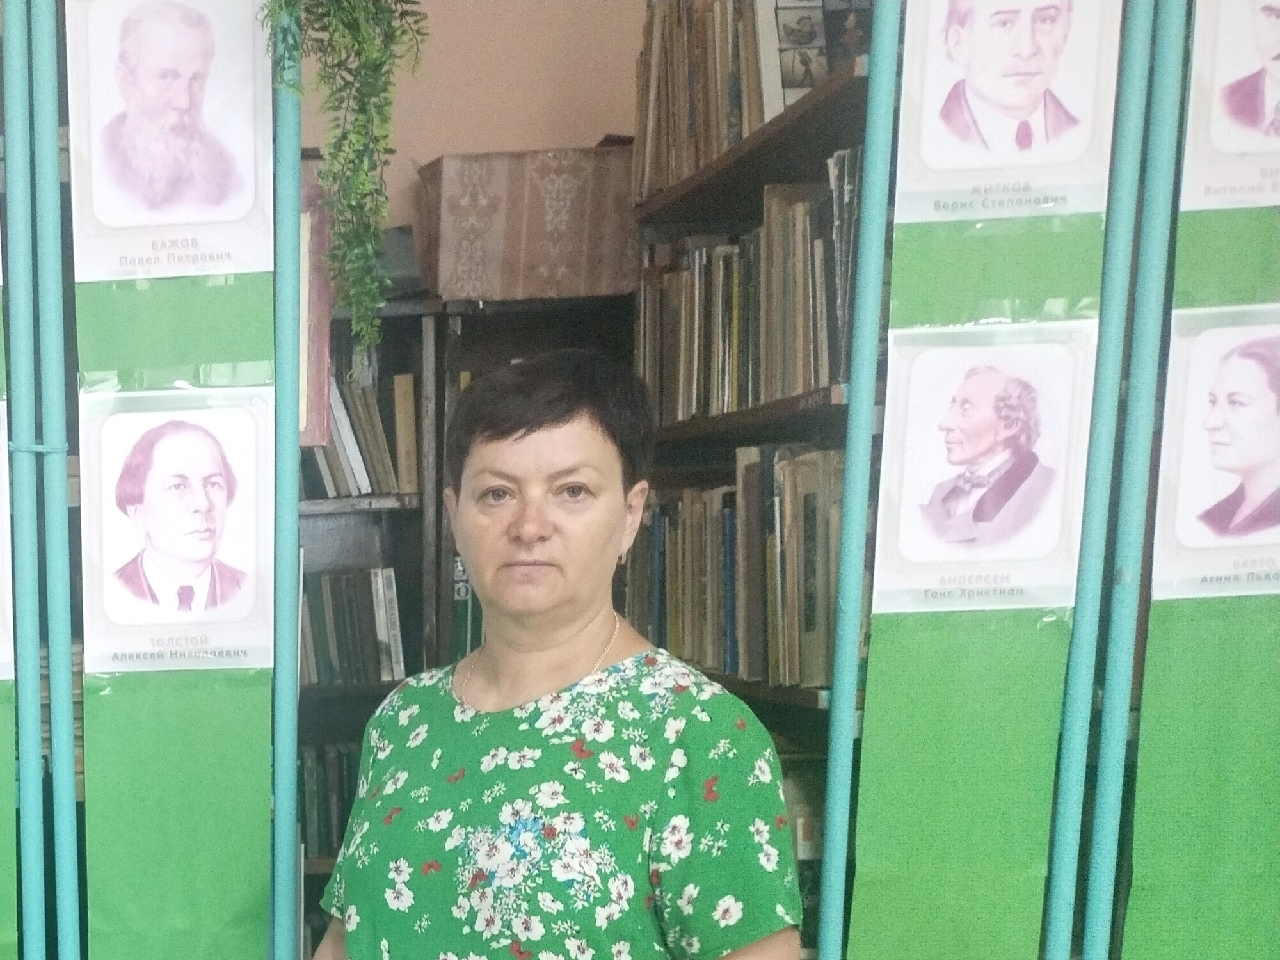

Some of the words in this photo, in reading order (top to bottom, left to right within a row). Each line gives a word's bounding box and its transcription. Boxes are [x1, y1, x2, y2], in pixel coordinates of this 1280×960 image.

[970, 180, 1032, 195] ЖИТКОВ
[933, 199, 975, 212] Борис
[981, 194, 1067, 209] Степанович
[152, 237, 199, 251] БАЖОВ
[119, 255, 160, 267] Павел
[167, 251, 231, 264] Петрович
[938, 573, 1010, 586] АНДЕРСЕН
[1200, 574, 1239, 584] Агния
[924, 588, 953, 600] Ганс
[958, 587, 1024, 599] Христиан
[149, 635, 209, 648] ТОЛСТОЙ
[112, 650, 164, 661] Алексей
[170, 649, 247, 659] Николаевич
